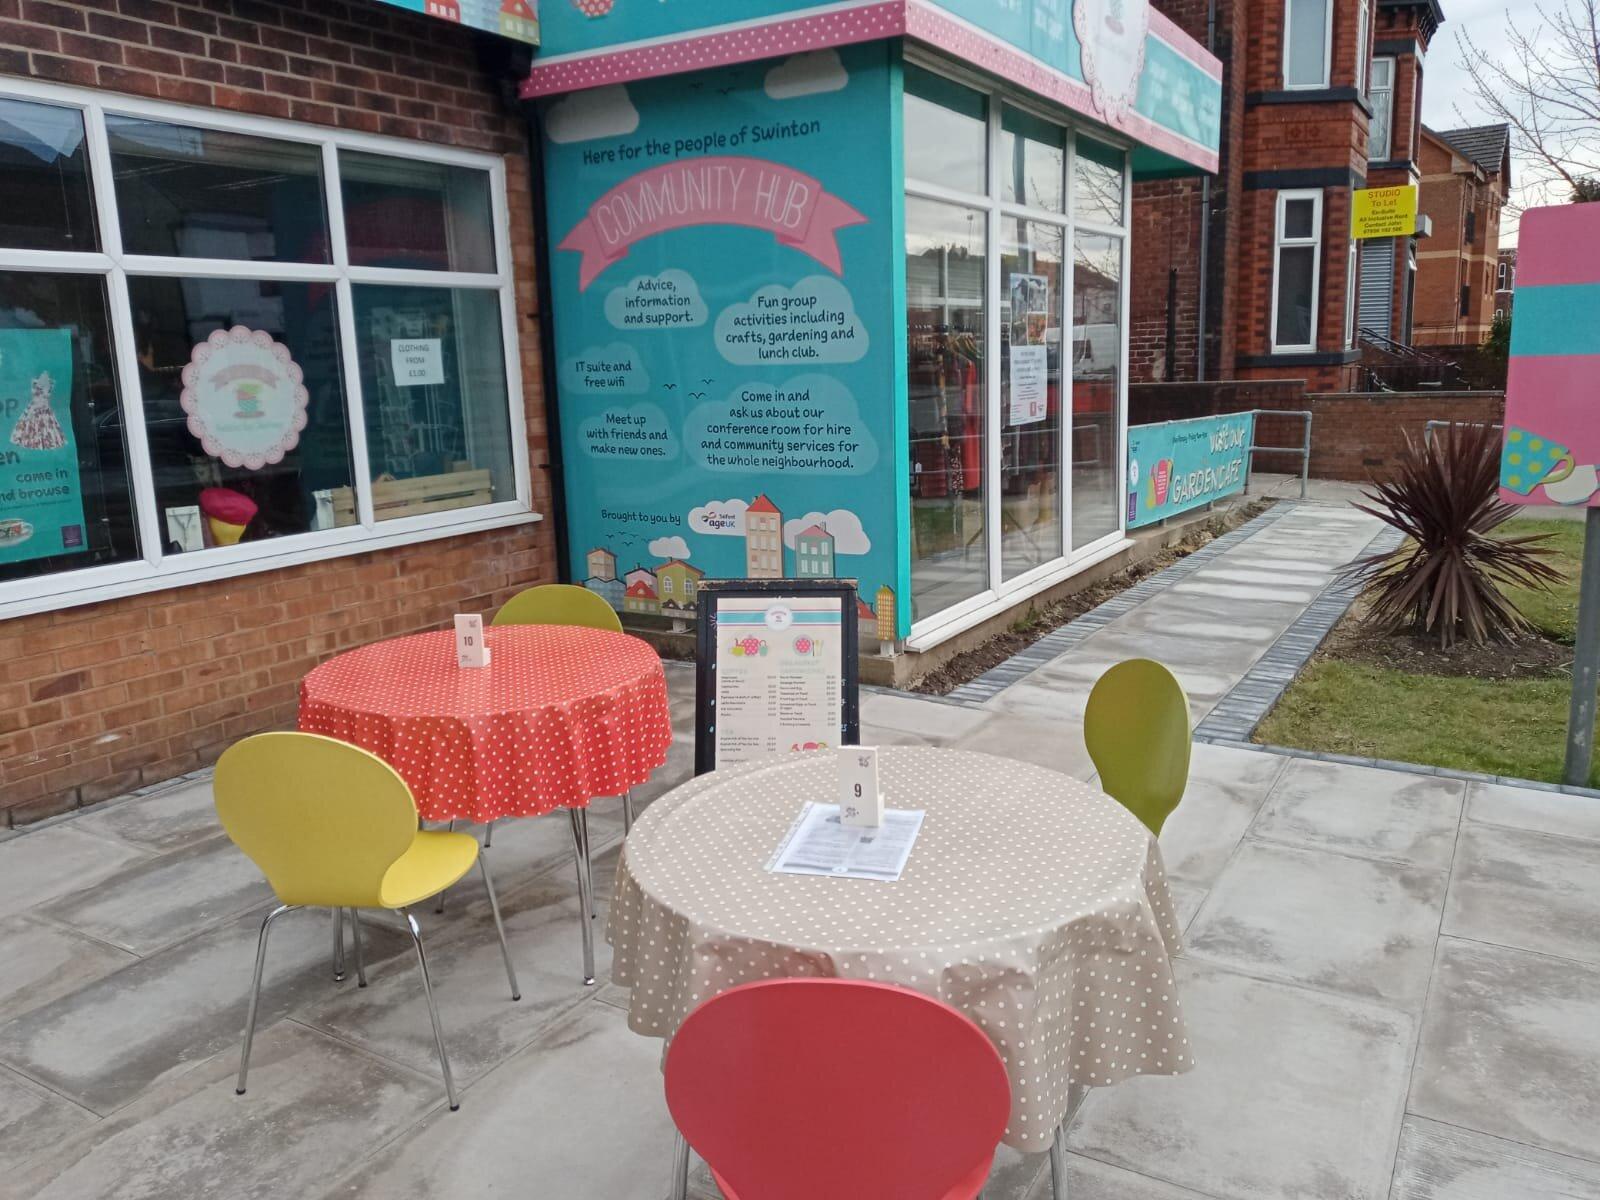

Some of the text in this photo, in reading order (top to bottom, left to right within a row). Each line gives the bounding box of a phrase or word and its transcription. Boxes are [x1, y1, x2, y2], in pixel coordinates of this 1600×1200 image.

[583, 119, 821, 165] Here for the people of Swinton
[1368, 189, 1401, 198] STUDIO
[596, 165, 808, 245] COMMUNITY HUB
[637, 279, 677, 292] Advice,
[625, 295, 691, 308] information
[758, 295, 817, 311] Fun group
[624, 310, 694, 325] and support.
[733, 310, 845, 326] activities including
[726, 326, 855, 345] crafts, gardening and
[758, 346, 820, 359] lunch club.
[575, 360, 632, 372] IT suite and
[584, 376, 625, 388] free wifi
[741, 389, 810, 402] Come in and
[729, 406, 824, 419] ask us about our
[606, 414, 646, 427] Meet up
[586, 428, 668, 440] with friends and
[706, 422, 851, 436] conference room for hire
[591, 443, 666, 456] make new ones.
[701, 438, 860, 454] and community services for
[706, 454, 854, 470] the whole neighbourhood.
[16, 468, 68, 483] come in
[18, 485, 70, 499] browse
[1172, 467, 1218, 504] GARDEN
[601, 509, 681, 526] Brought to you by
[464, 636, 473, 646] 10
[854, 784, 862, 798] 9
